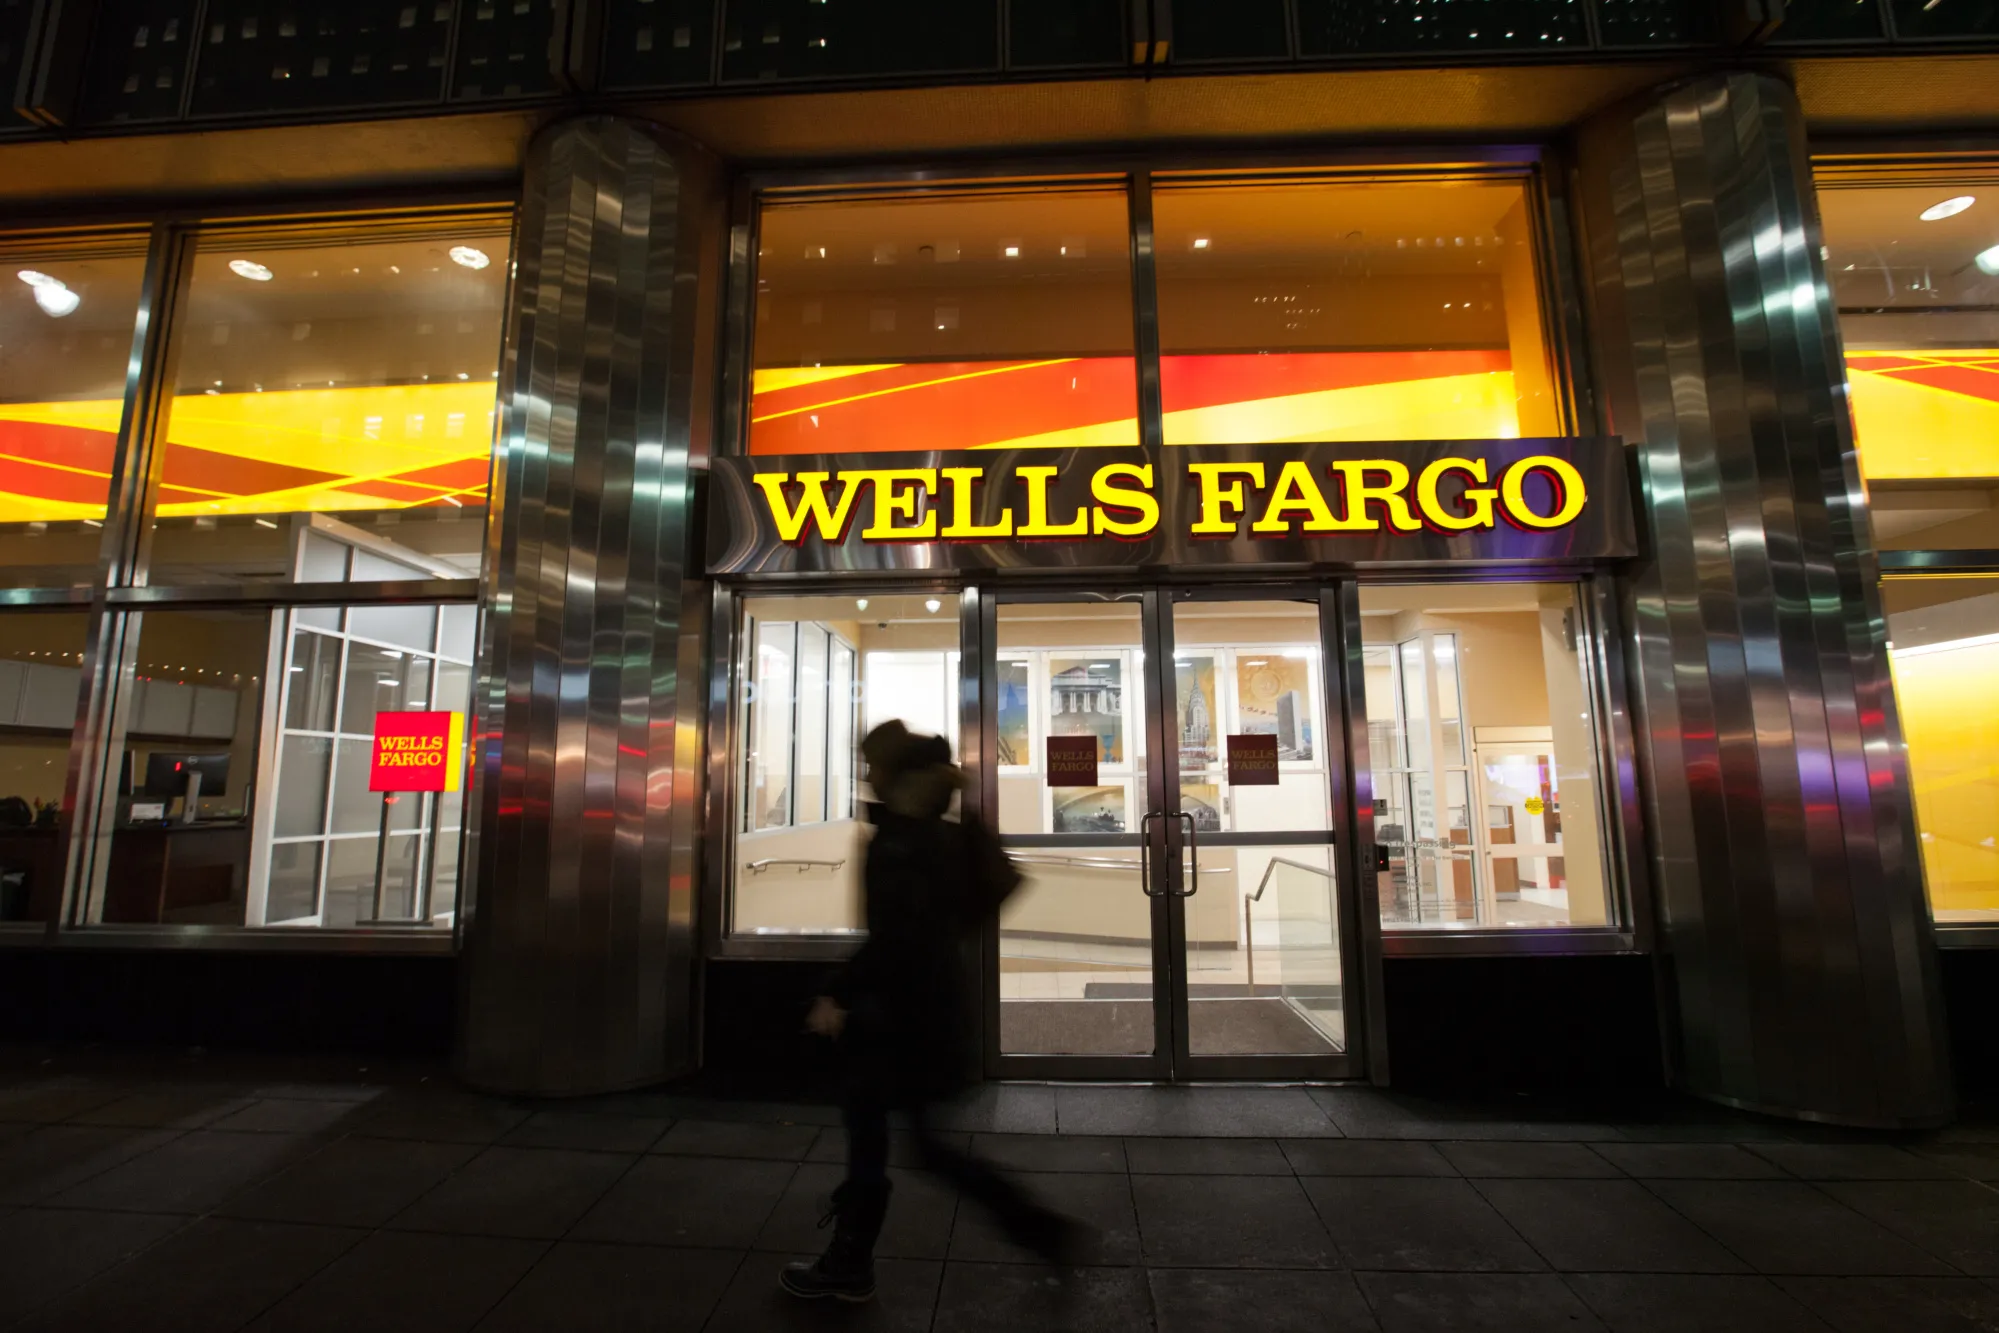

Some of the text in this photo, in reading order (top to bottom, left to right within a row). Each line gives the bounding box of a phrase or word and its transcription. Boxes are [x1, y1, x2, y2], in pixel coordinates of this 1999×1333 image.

[753, 455, 1587, 543] WELLS FARGO
[378, 735, 444, 750] WELLS
[378, 751, 442, 767] FARGO
[1050, 751, 1095, 761] WELLS
[1231, 749, 1276, 760] WELLS
[1051, 761, 1095, 772] FARGO
[1232, 760, 1276, 770] FARGO
